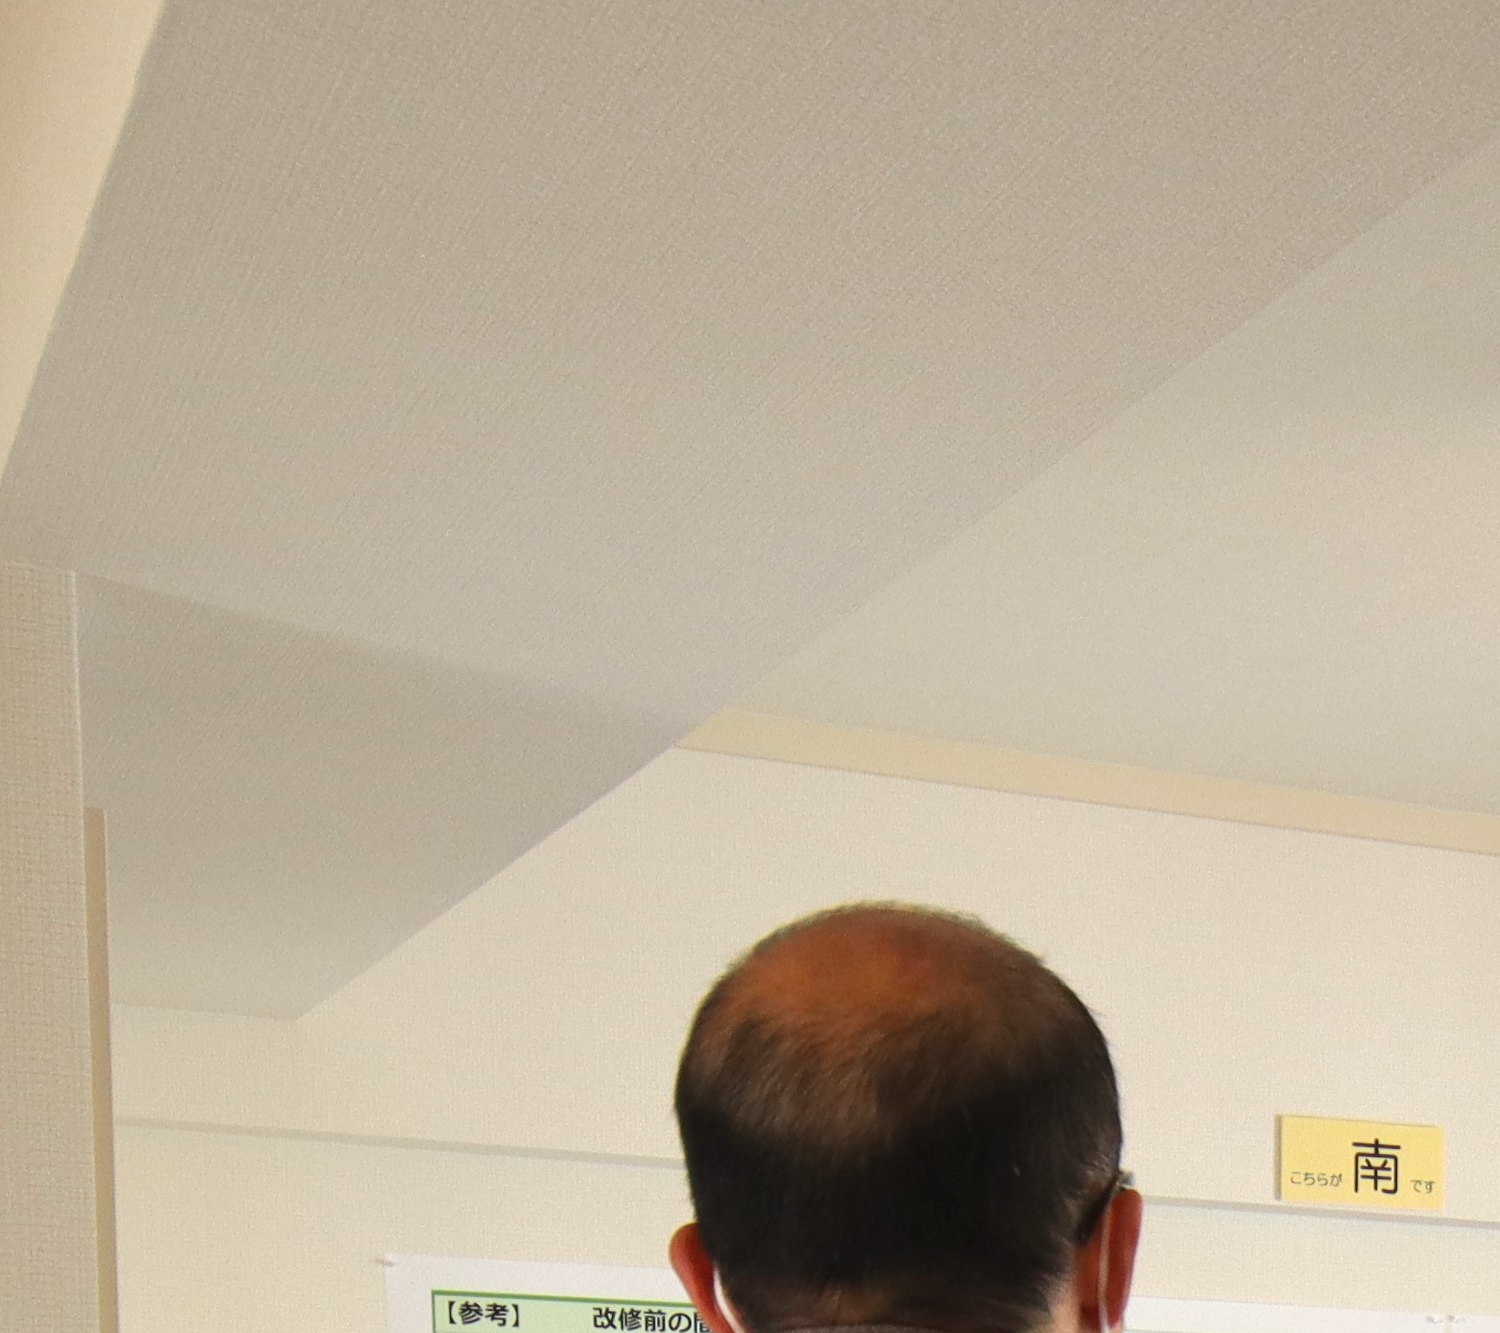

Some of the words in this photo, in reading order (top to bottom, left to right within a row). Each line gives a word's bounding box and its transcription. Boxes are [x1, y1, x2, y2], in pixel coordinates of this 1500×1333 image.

[1289, 1171, 1343, 1188] こちらが
[1351, 1137, 1402, 1195] 南
[1410, 1178, 1436, 1194] です
[444, 1299, 521, 1328] 【参考】
